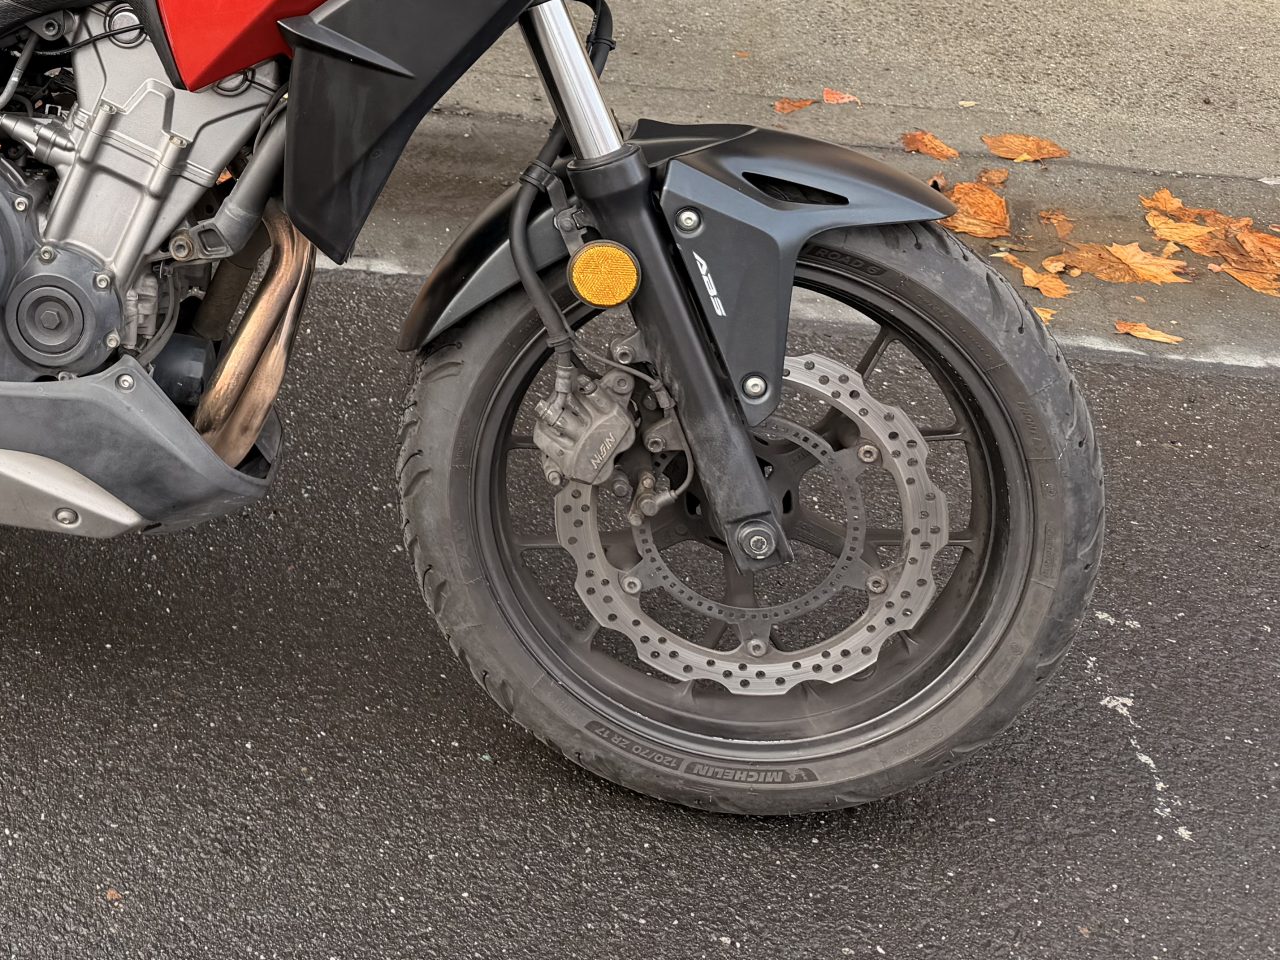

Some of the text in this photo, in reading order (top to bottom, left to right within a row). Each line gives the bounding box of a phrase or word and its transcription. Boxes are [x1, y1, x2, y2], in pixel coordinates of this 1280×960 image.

[815, 248, 865, 268] ROAD
[692, 250, 727, 317] ABS
[593, 726, 678, 768] 120/70 ZR 17
[692, 761, 784, 784] MICHELIN
